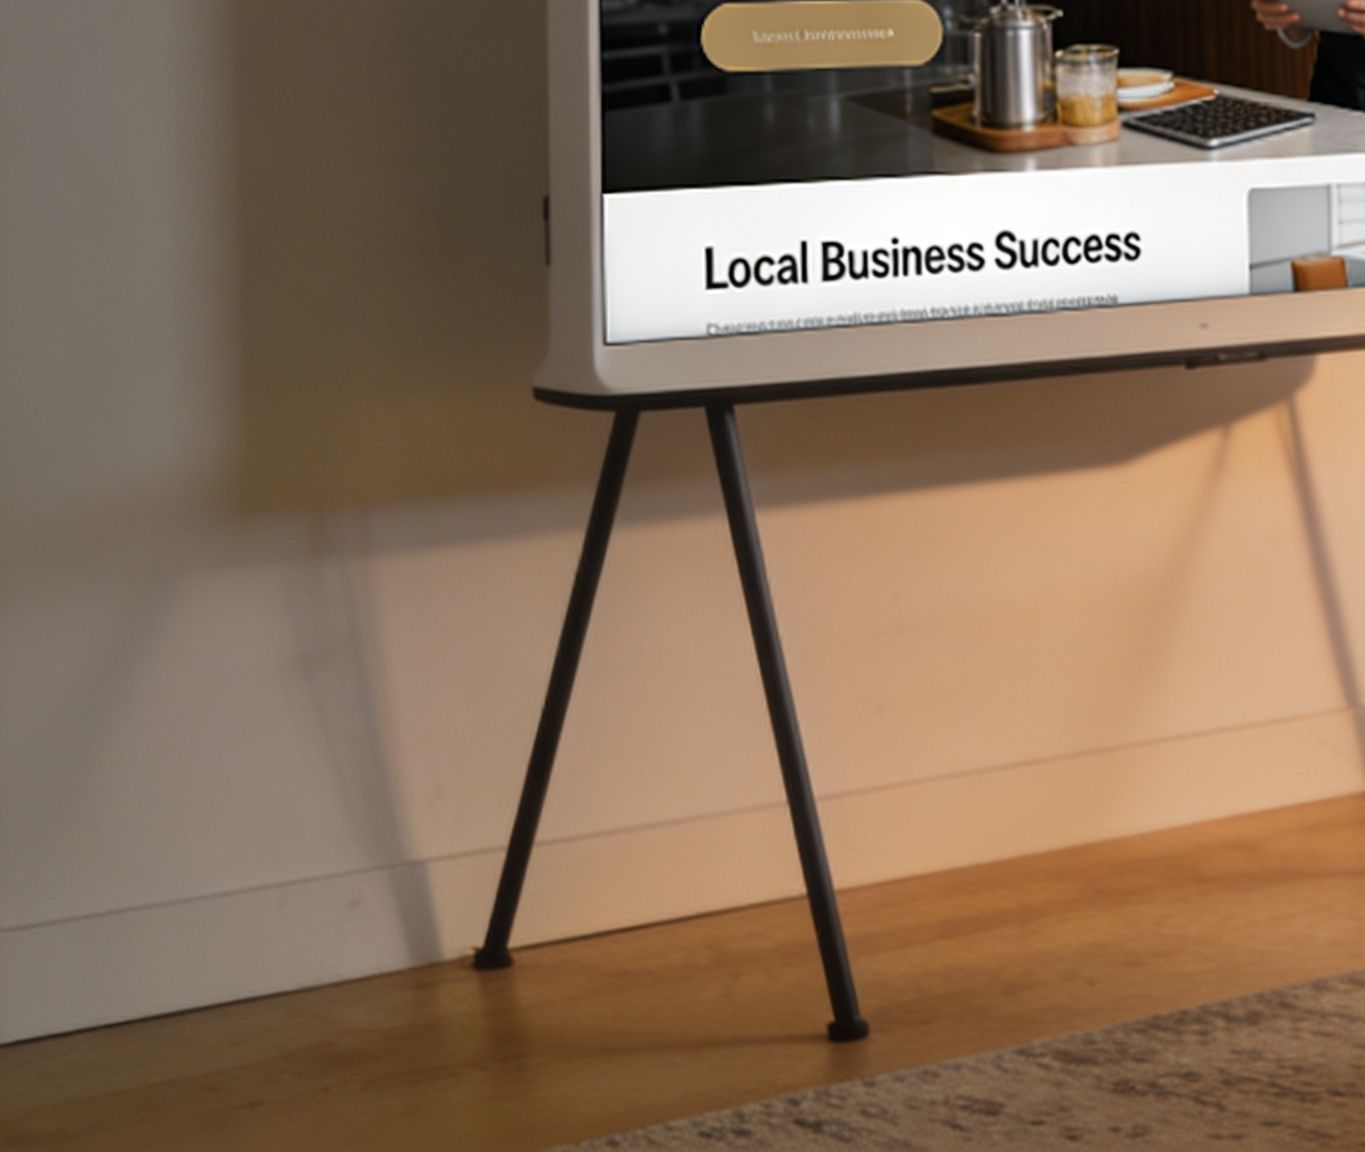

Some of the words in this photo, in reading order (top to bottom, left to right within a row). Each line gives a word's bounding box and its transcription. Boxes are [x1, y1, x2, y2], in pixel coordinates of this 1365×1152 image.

[704, 241, 808, 290] Local
[821, 237, 985, 282] Business
[994, 230, 1141, 270] Success
